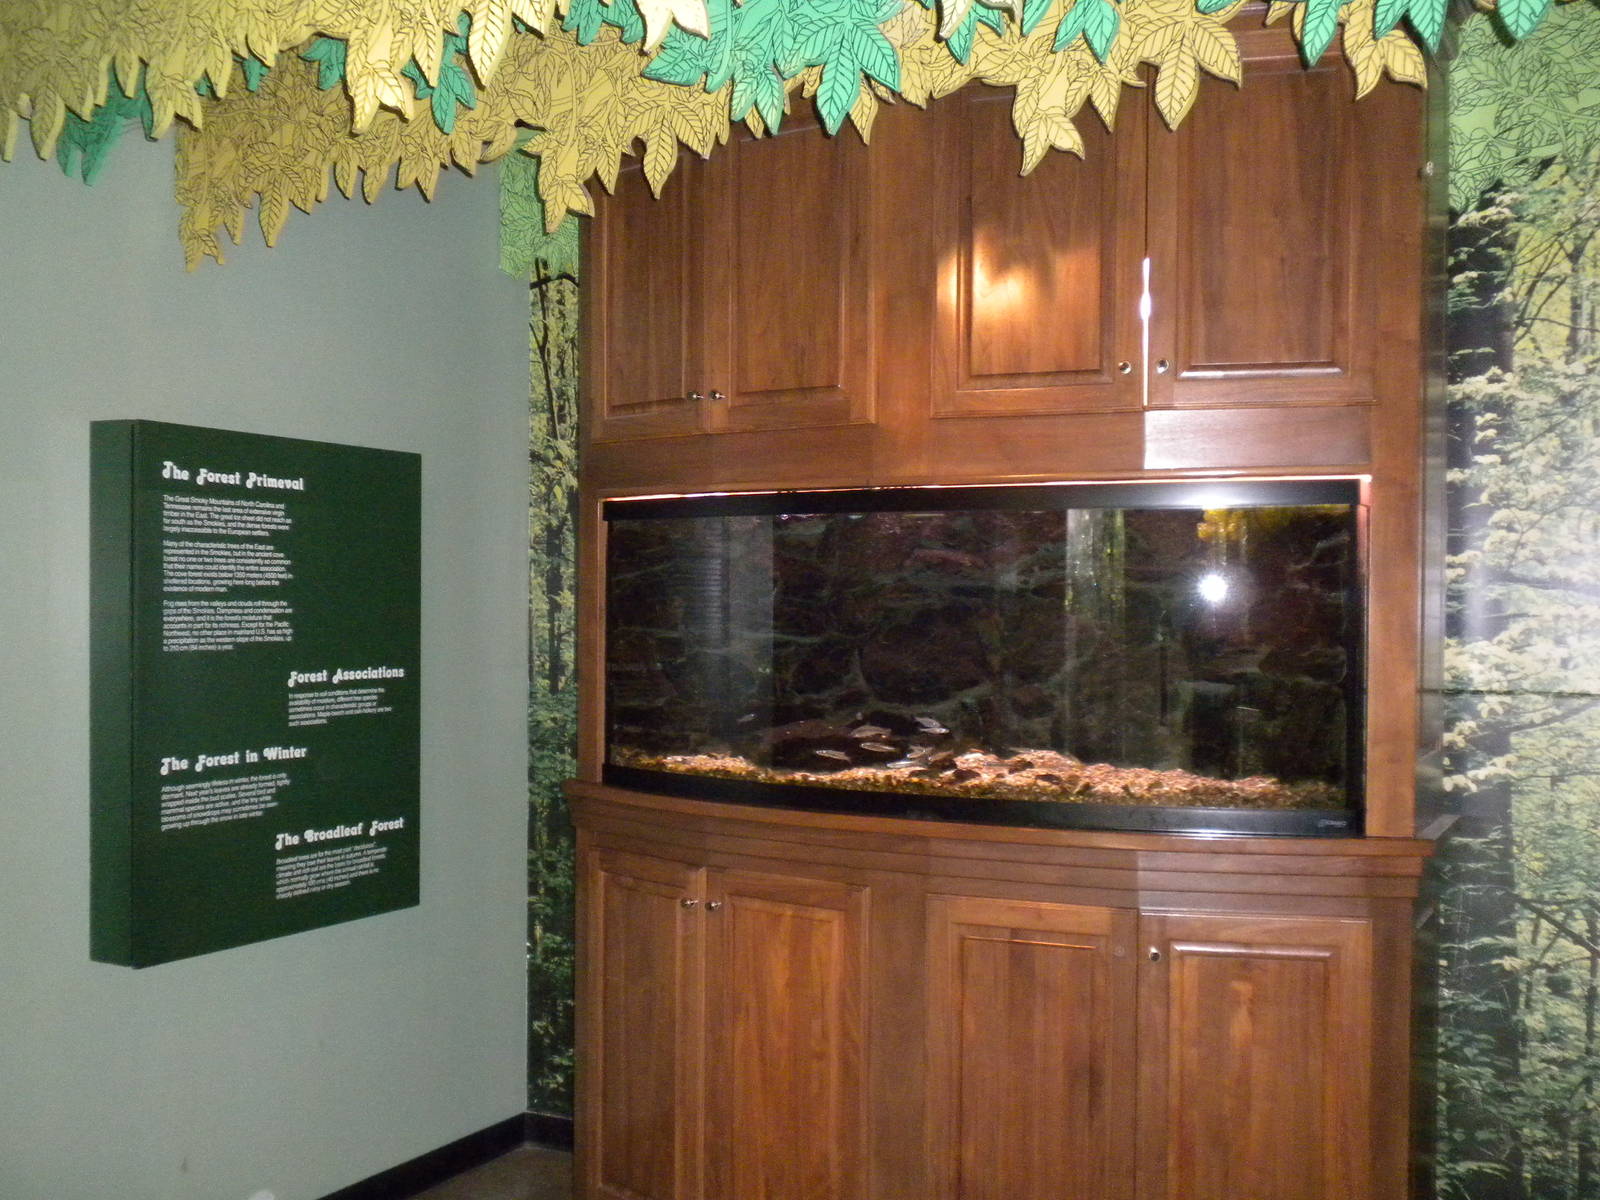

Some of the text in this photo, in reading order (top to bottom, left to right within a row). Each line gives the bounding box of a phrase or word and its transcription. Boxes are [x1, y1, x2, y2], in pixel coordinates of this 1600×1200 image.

[162, 461, 304, 491] The Forest Primeval
[288, 666, 405, 687] Forest Associations
[160, 746, 308, 775] The Forest in Winter
[275, 817, 404, 850] The Broadleaf Forest
